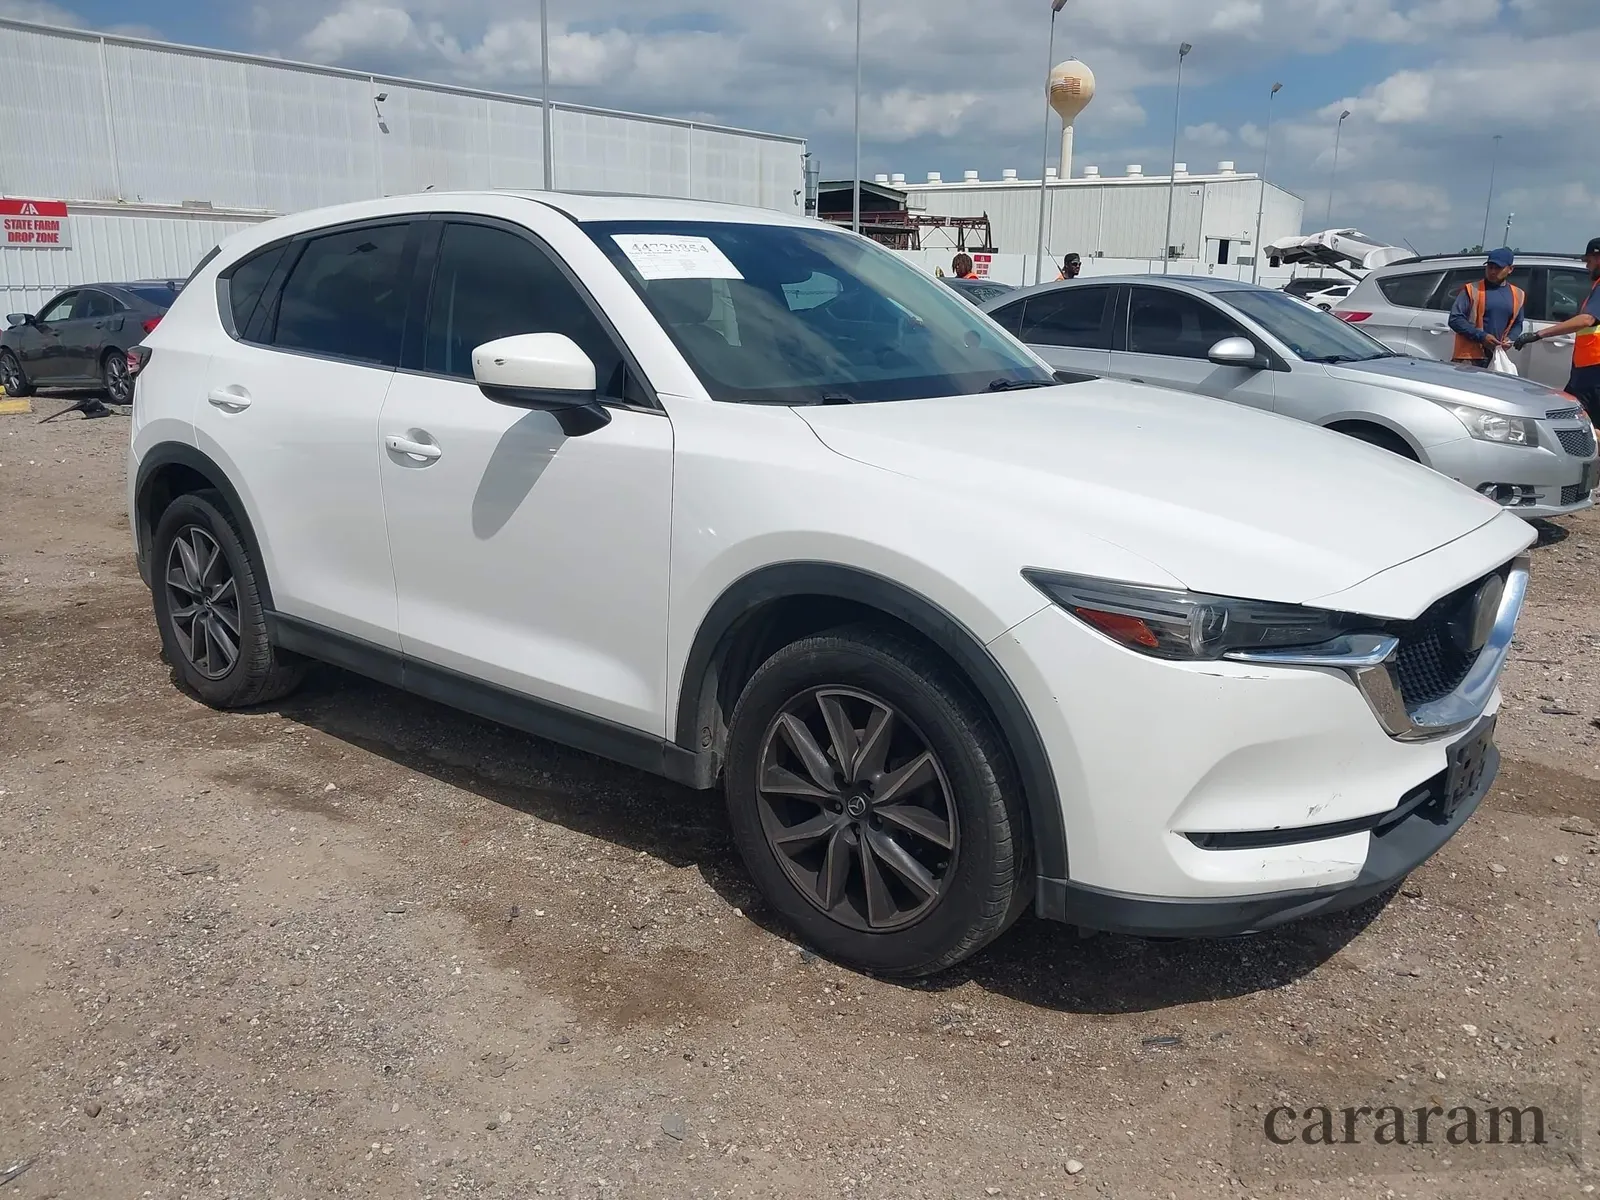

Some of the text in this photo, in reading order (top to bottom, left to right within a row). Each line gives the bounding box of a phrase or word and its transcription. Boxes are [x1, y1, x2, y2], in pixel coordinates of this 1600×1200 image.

[4, 219, 60, 231] STATE FARM
[8, 232, 59, 243] DROP ZONE
